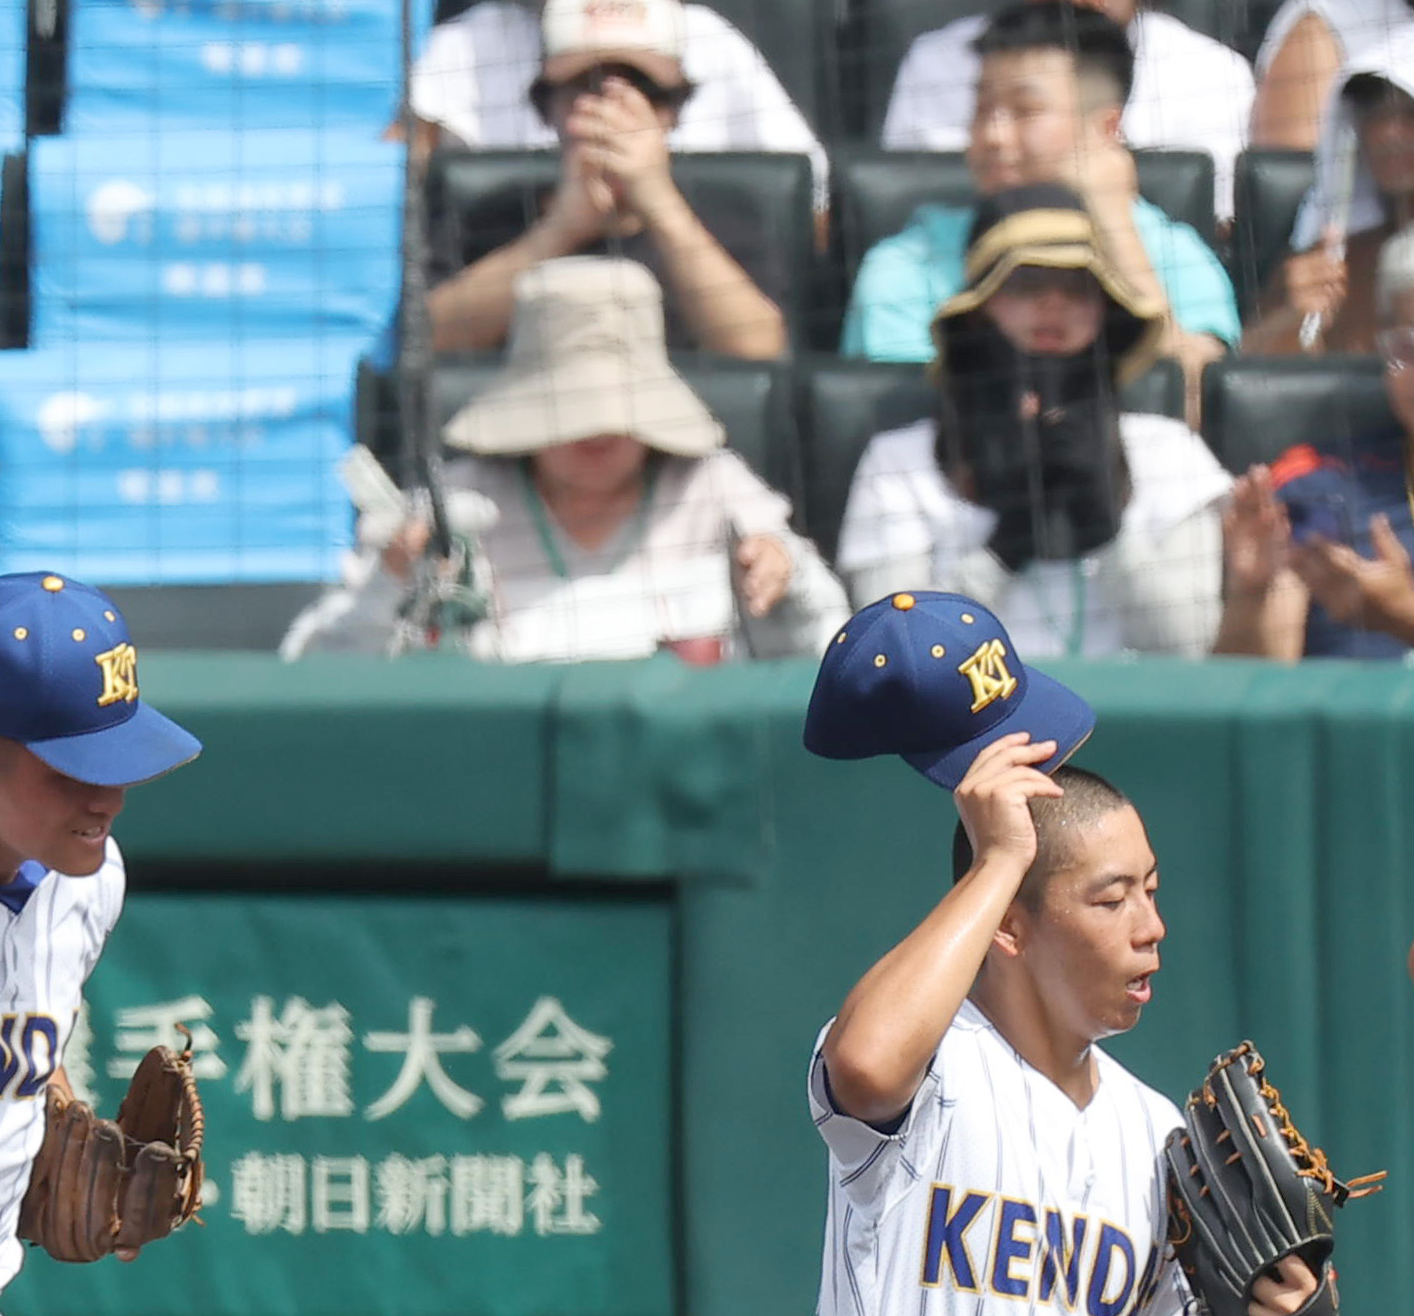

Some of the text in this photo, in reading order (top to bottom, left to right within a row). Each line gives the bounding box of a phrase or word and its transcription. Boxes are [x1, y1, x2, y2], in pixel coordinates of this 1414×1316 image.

[94, 642, 139, 706] KT
[957, 638, 1019, 713] KT
[62, 995, 614, 1123] 手権大会
